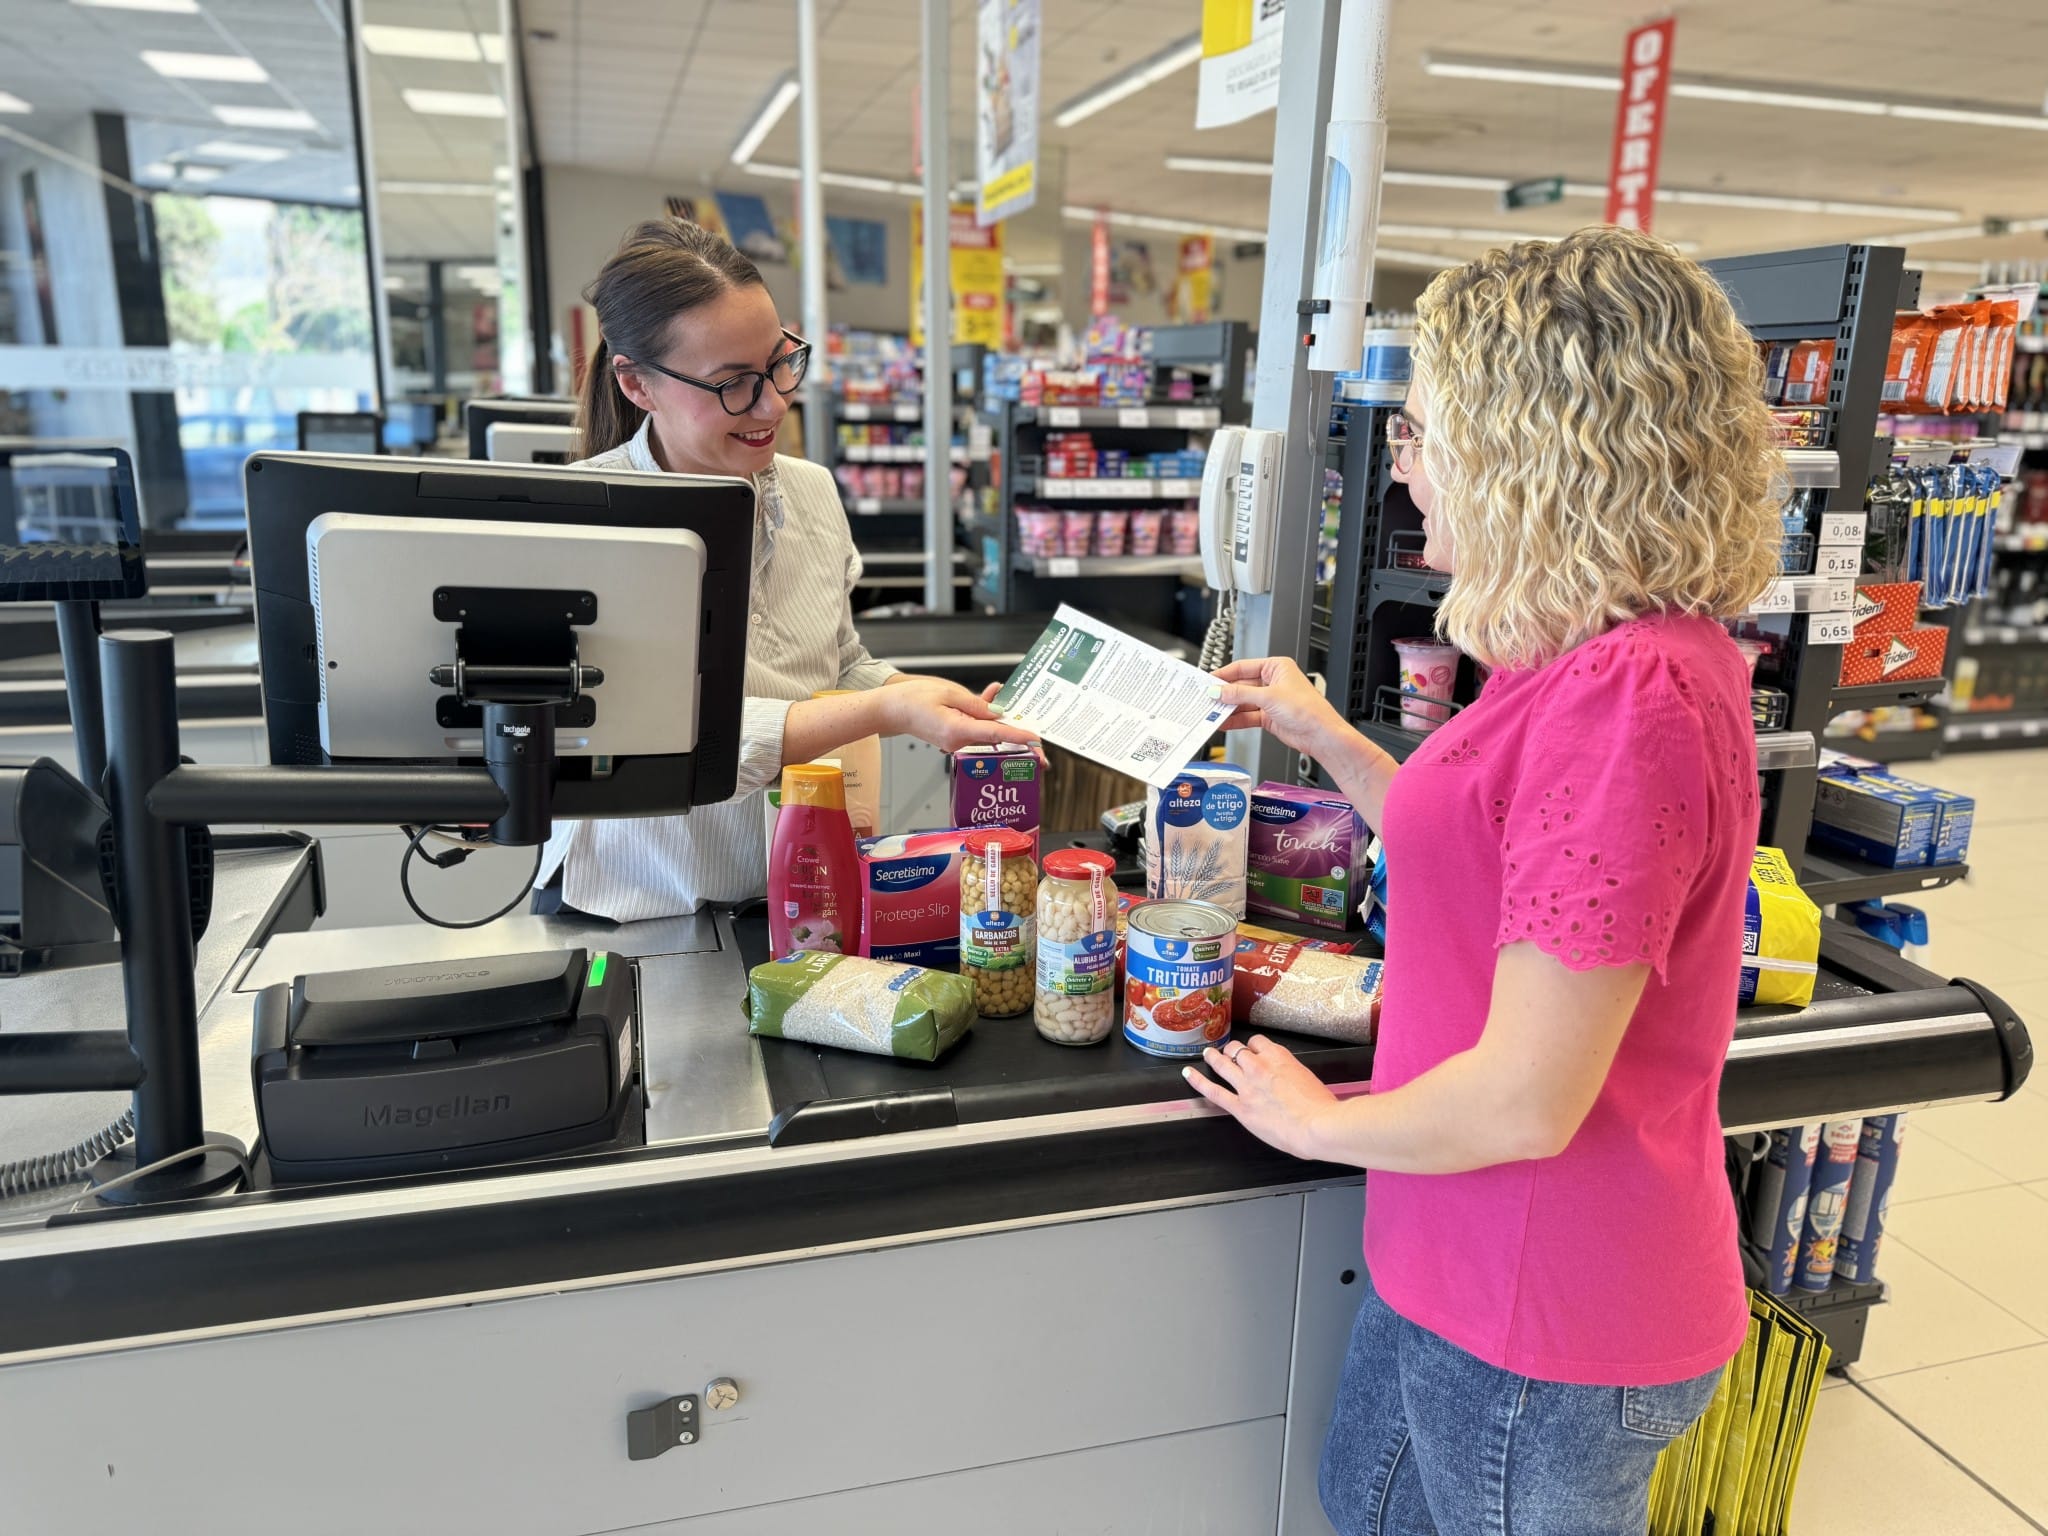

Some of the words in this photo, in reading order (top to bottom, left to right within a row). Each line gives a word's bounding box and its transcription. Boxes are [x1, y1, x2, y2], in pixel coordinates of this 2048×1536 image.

[1852, 600, 1884, 617] rident
[1884, 647, 1917, 665] Trident
[978, 784, 1019, 809] Sin
[1169, 799, 1200, 808] alteza
[971, 804, 1027, 823] lactosa
[1217, 800, 1243, 811] trigo
[1272, 828, 1343, 853] touch
[876, 866, 935, 882] Secretisima
[875, 907, 925, 923] Protege
[928, 902, 950, 917] Slip
[975, 929, 1017, 940] GARBANZOS
[903, 950, 921, 959] Maxi
[1074, 953, 1098, 965] ALUBIAS
[1147, 967, 1224, 987] TRITURADO
[1176, 965, 1200, 973] TOMATE
[363, 1094, 511, 1129] Magellan
